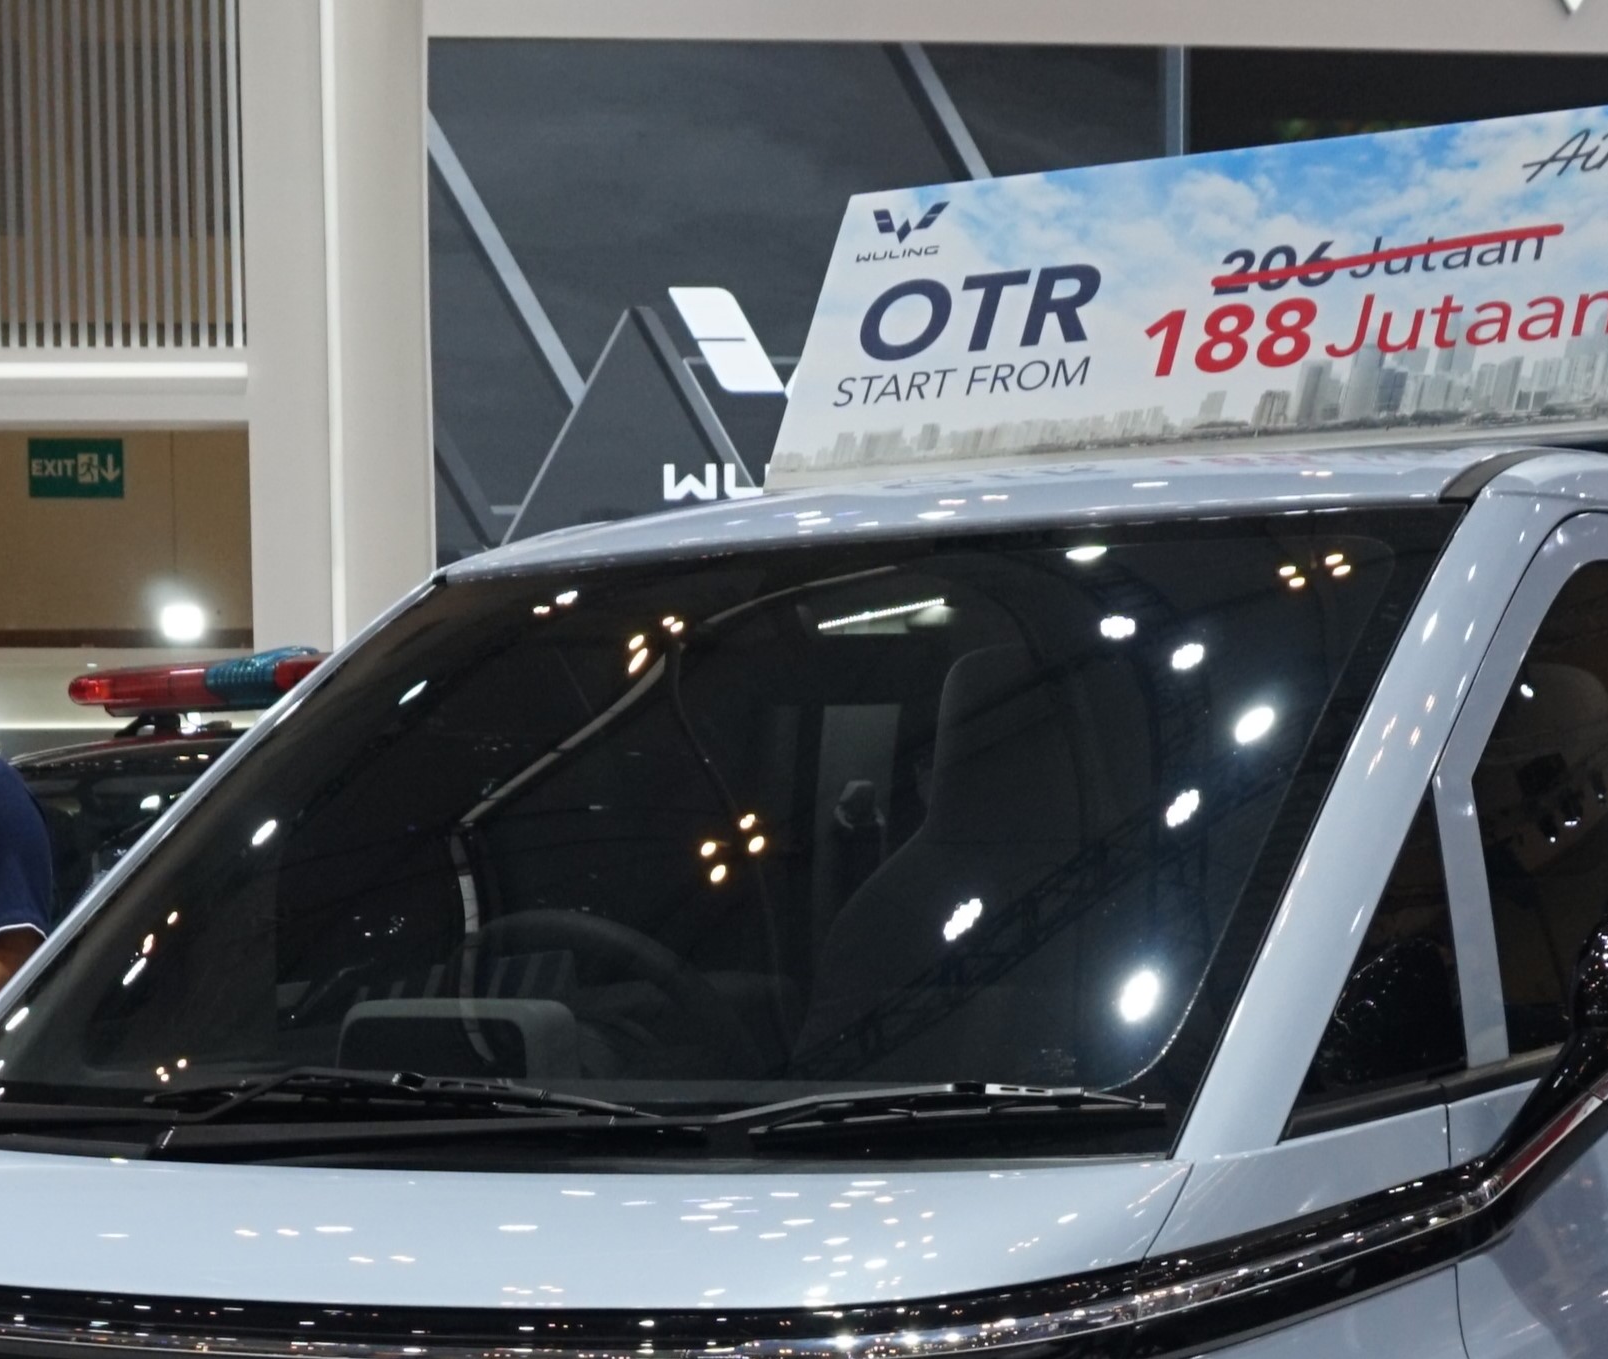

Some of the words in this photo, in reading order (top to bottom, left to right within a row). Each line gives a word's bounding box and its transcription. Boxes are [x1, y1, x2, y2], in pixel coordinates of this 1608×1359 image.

[855, 244, 940, 264] WULING
[1212, 239, 1336, 296] 206
[1349, 235, 1546, 280] Jutaan
[859, 263, 1102, 362] OTR
[1143, 297, 1318, 378] 188
[832, 367, 958, 408] START
[965, 356, 1091, 397] FROM
[31, 458, 76, 477] EXIT
